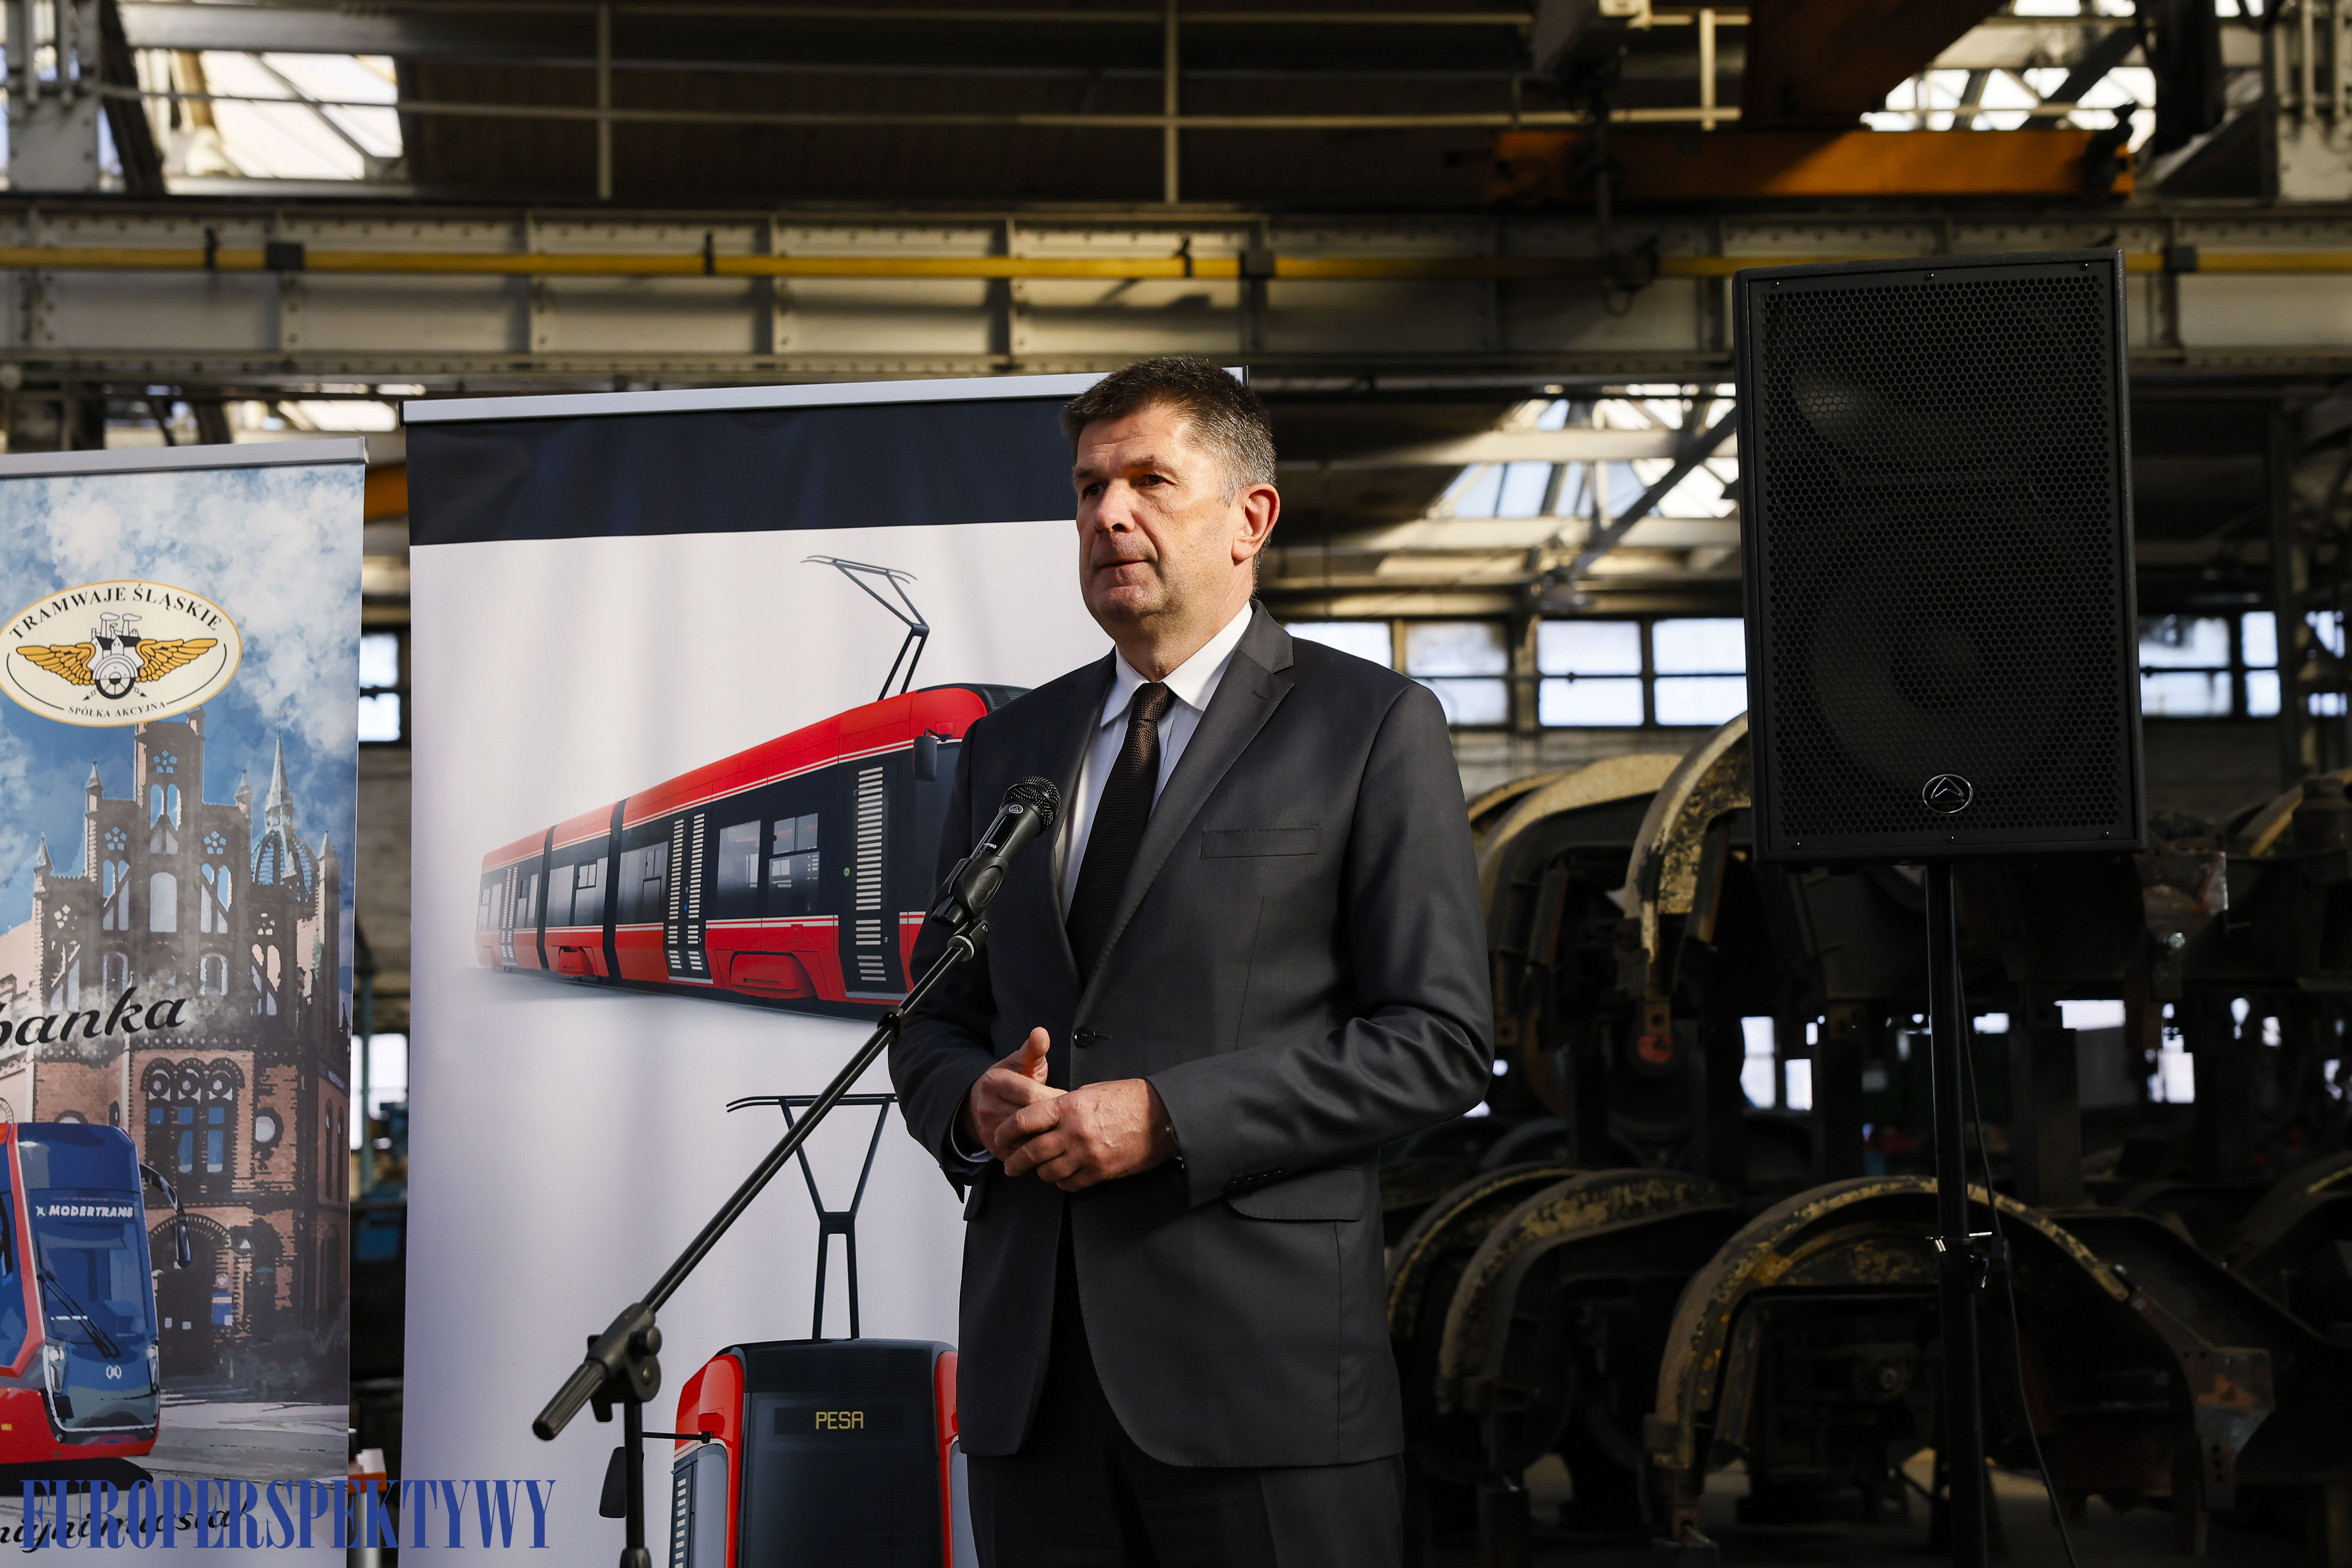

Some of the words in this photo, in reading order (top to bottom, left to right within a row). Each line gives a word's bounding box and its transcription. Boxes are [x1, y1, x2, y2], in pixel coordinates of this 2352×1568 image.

[9, 587, 126, 641] TRAMWAJE
[132, 584, 221, 631] ŚLĄSKIE
[68, 705, 111, 718] SPÓŁKA
[115, 701, 166, 717] AKCYJNA
[816, 1411, 864, 1429] PESA
